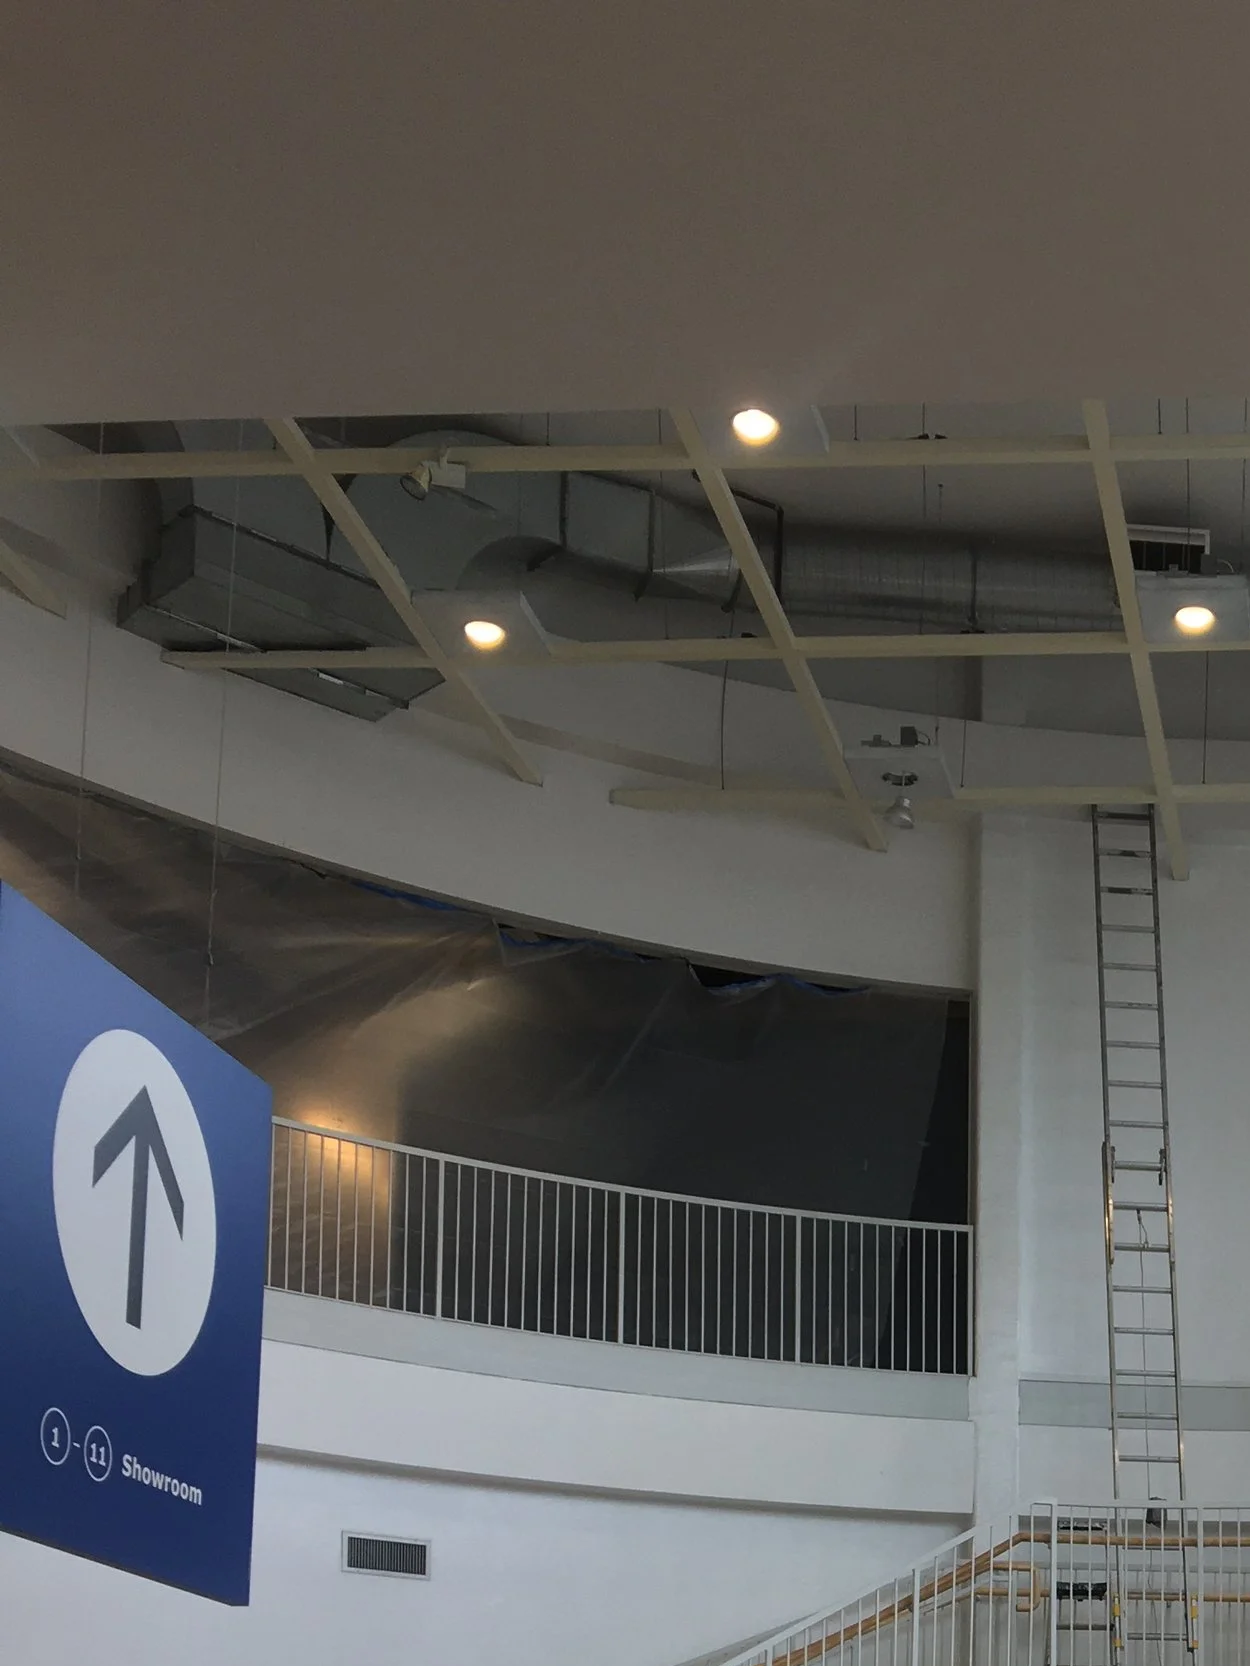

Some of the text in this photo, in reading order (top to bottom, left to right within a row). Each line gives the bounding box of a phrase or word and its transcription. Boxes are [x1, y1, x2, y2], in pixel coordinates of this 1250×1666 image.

[51, 1427, 60, 1449] 1
[89, 1442, 107, 1467] 11
[121, 1453, 203, 1506] Showroom
